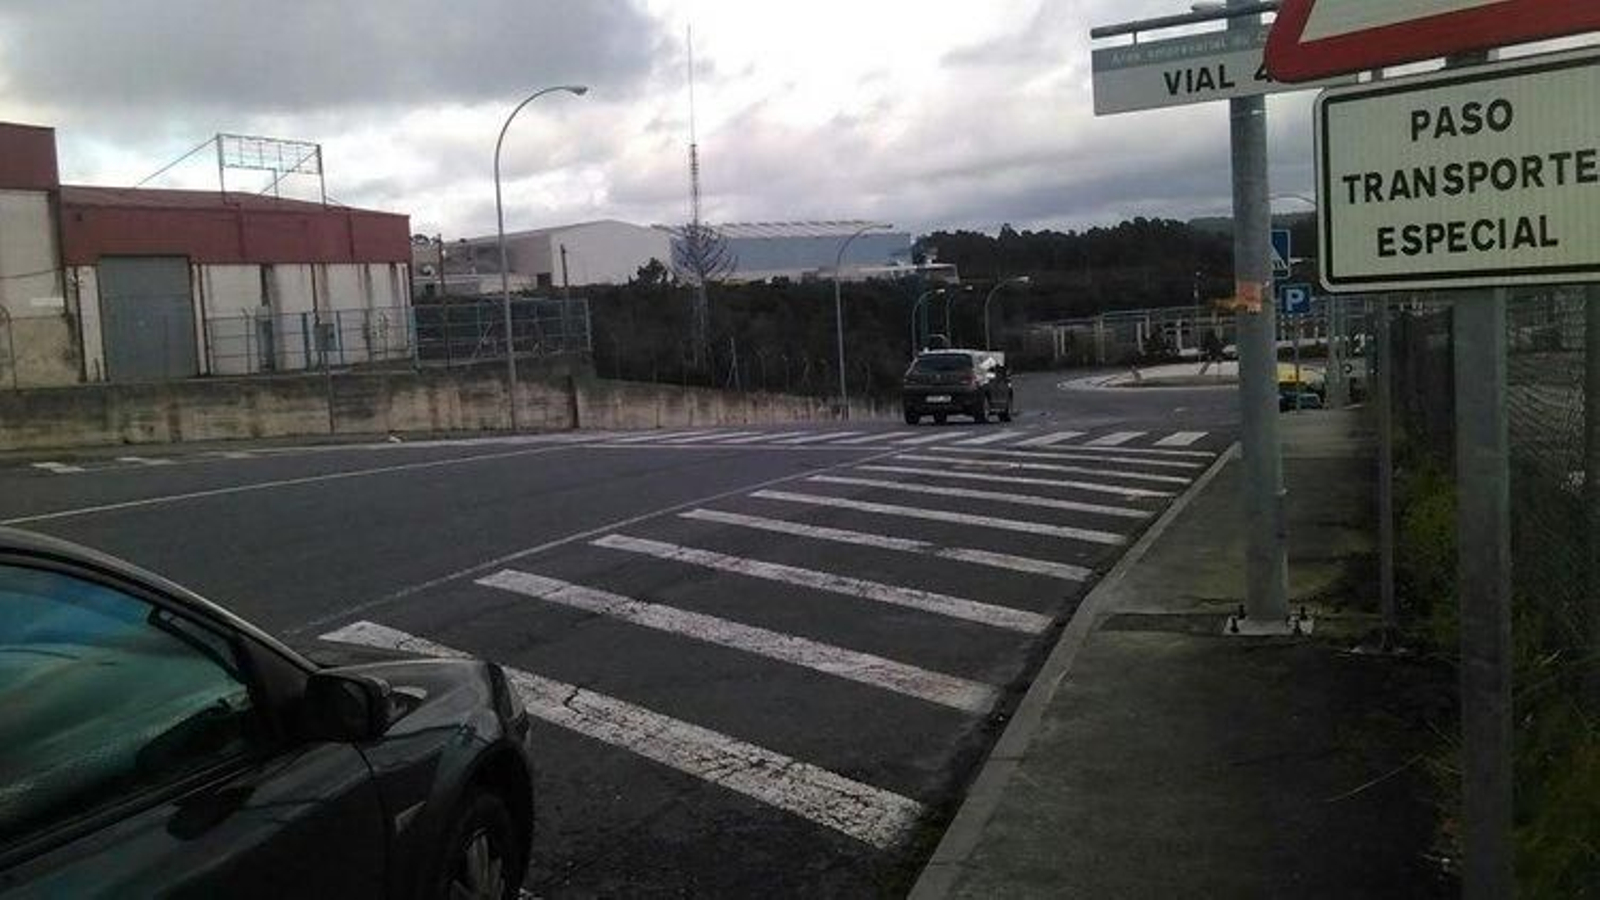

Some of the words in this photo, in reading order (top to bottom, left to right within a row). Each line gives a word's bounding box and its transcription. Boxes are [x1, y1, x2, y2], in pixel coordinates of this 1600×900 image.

[1164, 64, 1236, 96] VIAL
[1410, 98, 1514, 142] PASO
[1342, 148, 1600, 205] TRANSPORTE
[1377, 214, 1559, 258] ESPECIAL
[1285, 288, 1305, 312] P
